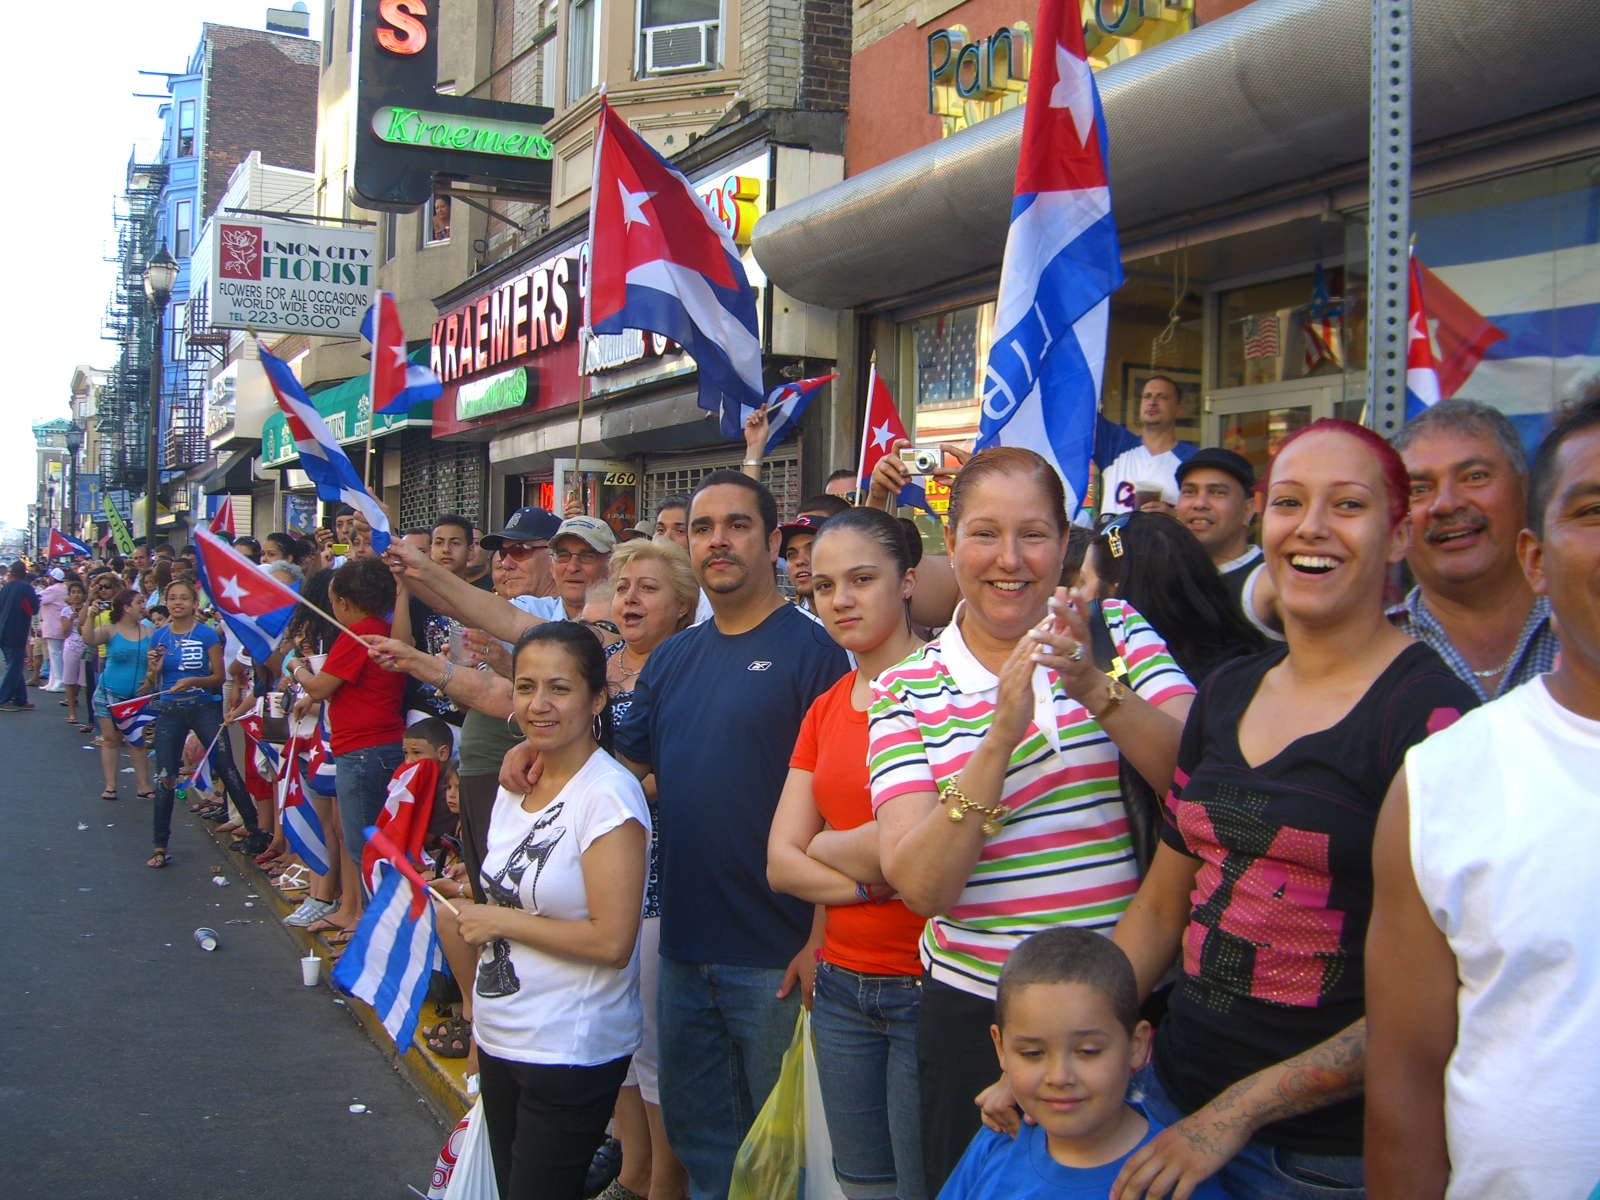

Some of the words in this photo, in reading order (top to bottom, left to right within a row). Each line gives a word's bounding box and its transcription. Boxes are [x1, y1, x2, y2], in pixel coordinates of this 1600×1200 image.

[928, 27, 1013, 115] Pan
[385, 108, 553, 159] Kraemers
[263, 240, 321, 257] UNION
[326, 245, 373, 261] CITY
[262, 256, 374, 286] FLORIST
[219, 282, 262, 299] FLOWERS
[266, 286, 286, 300] FOR
[291, 288, 308, 302] ALL
[308, 289, 368, 307] OCCASIONS
[231, 297, 274, 310] WORLD
[280, 300, 307, 313] WIDE
[313, 303, 357, 317] SERVICE
[229, 311, 246, 322] TEL.
[248, 310, 340, 329] 223-0300
[430, 256, 569, 384] KRAEMERS
[606, 472, 636, 485] 460
